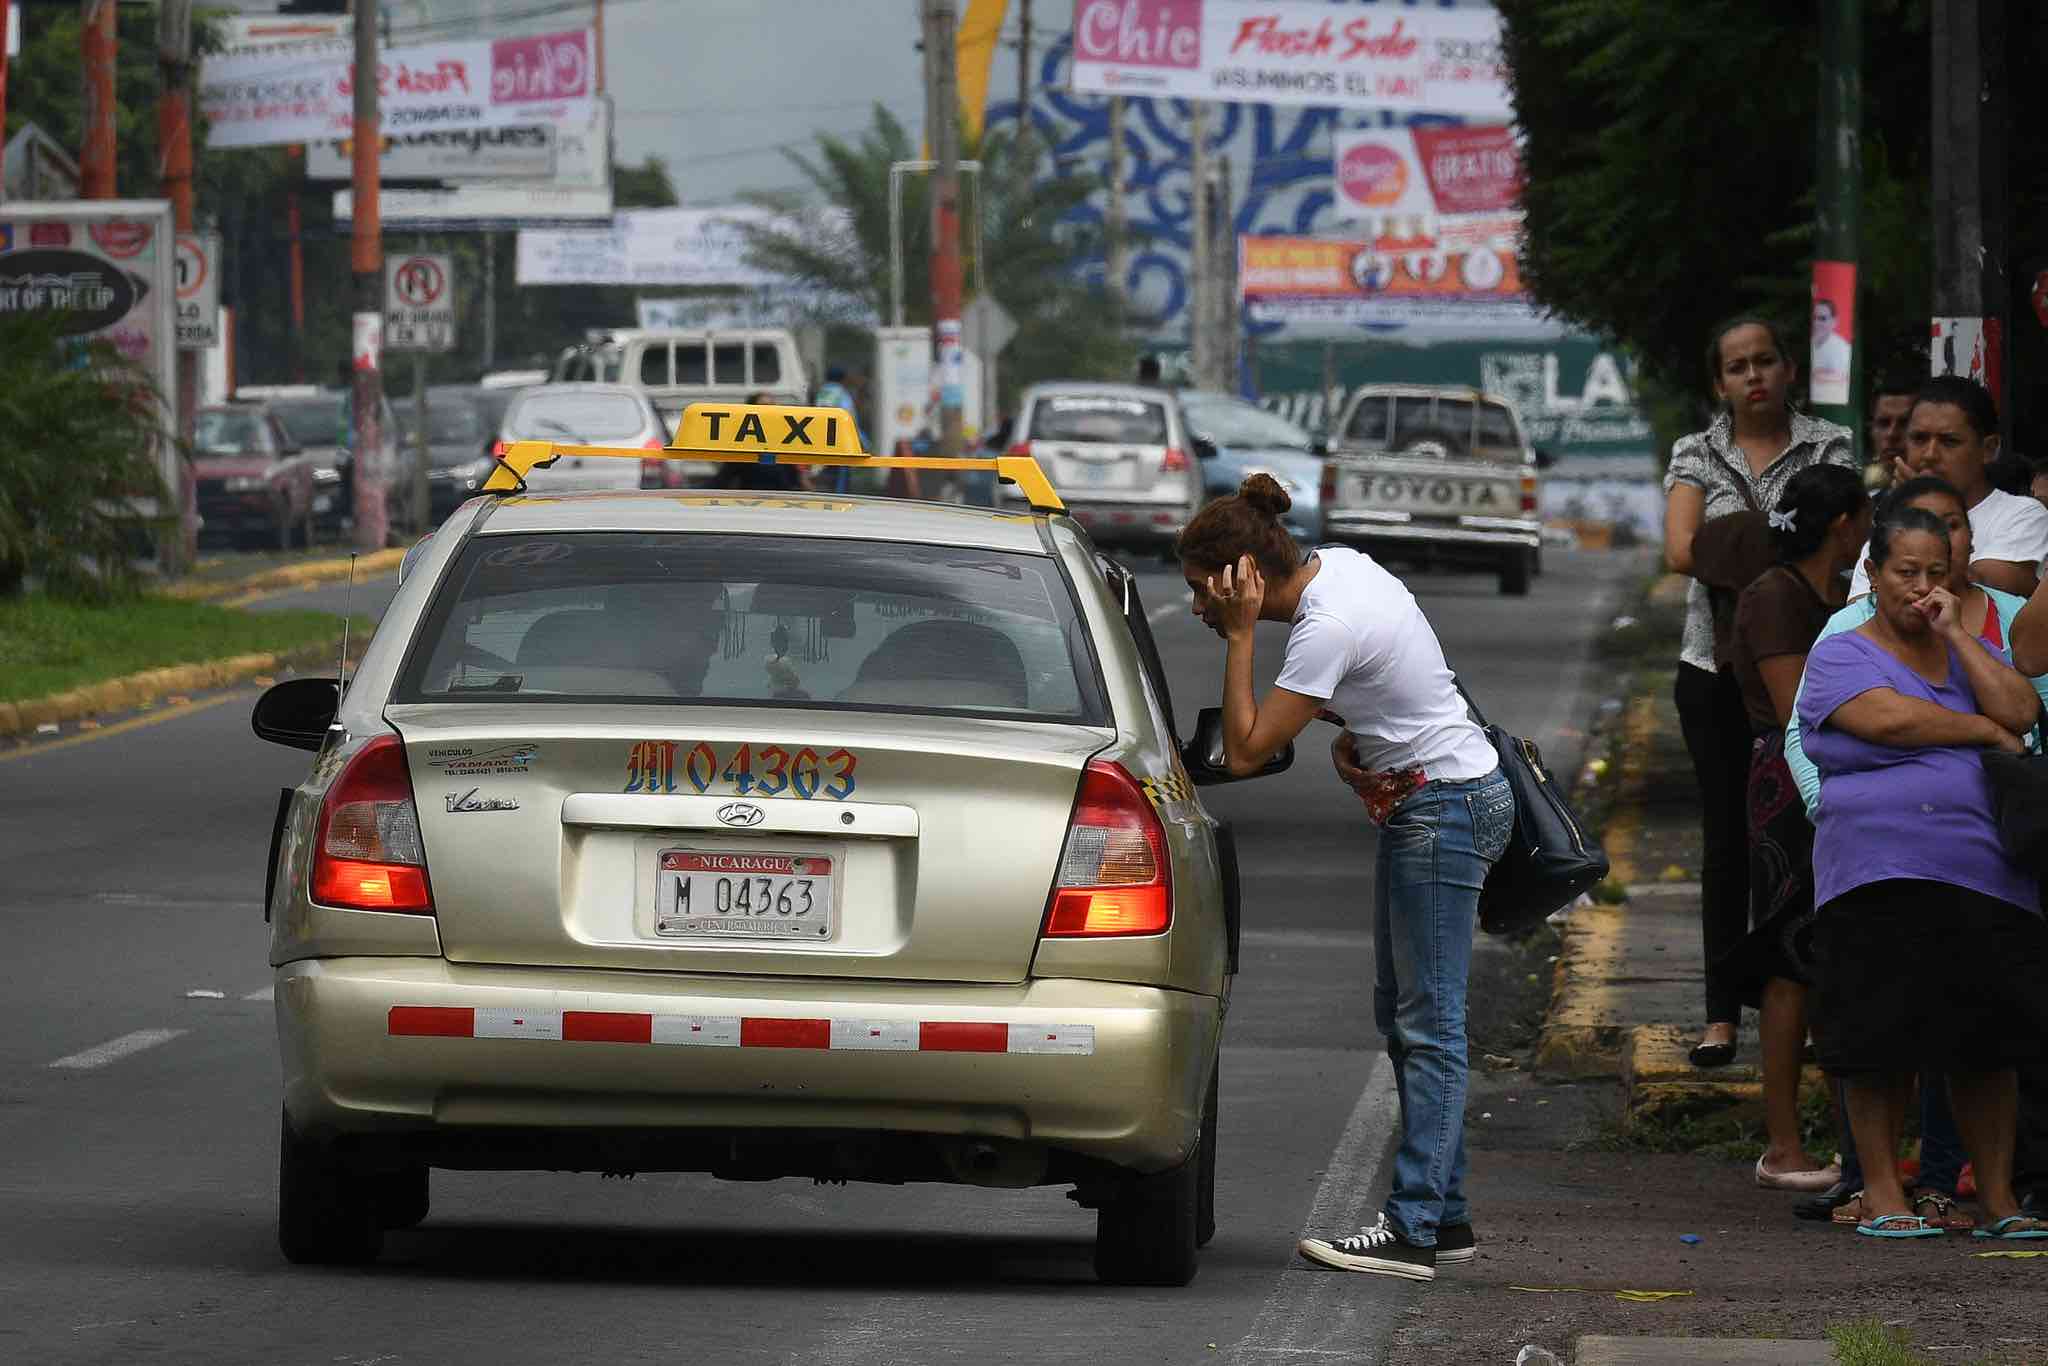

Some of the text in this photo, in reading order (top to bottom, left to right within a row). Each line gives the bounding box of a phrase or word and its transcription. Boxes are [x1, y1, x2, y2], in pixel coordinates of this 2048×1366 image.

[1080, 0, 1196, 63] Chic
[1229, 15, 1418, 61] Flash Sale
[701, 411, 838, 447] TAXI
[1360, 475, 1498, 508] TOYOTA
[623, 740, 858, 800] M 04363
[674, 876, 814, 915] M 04363
